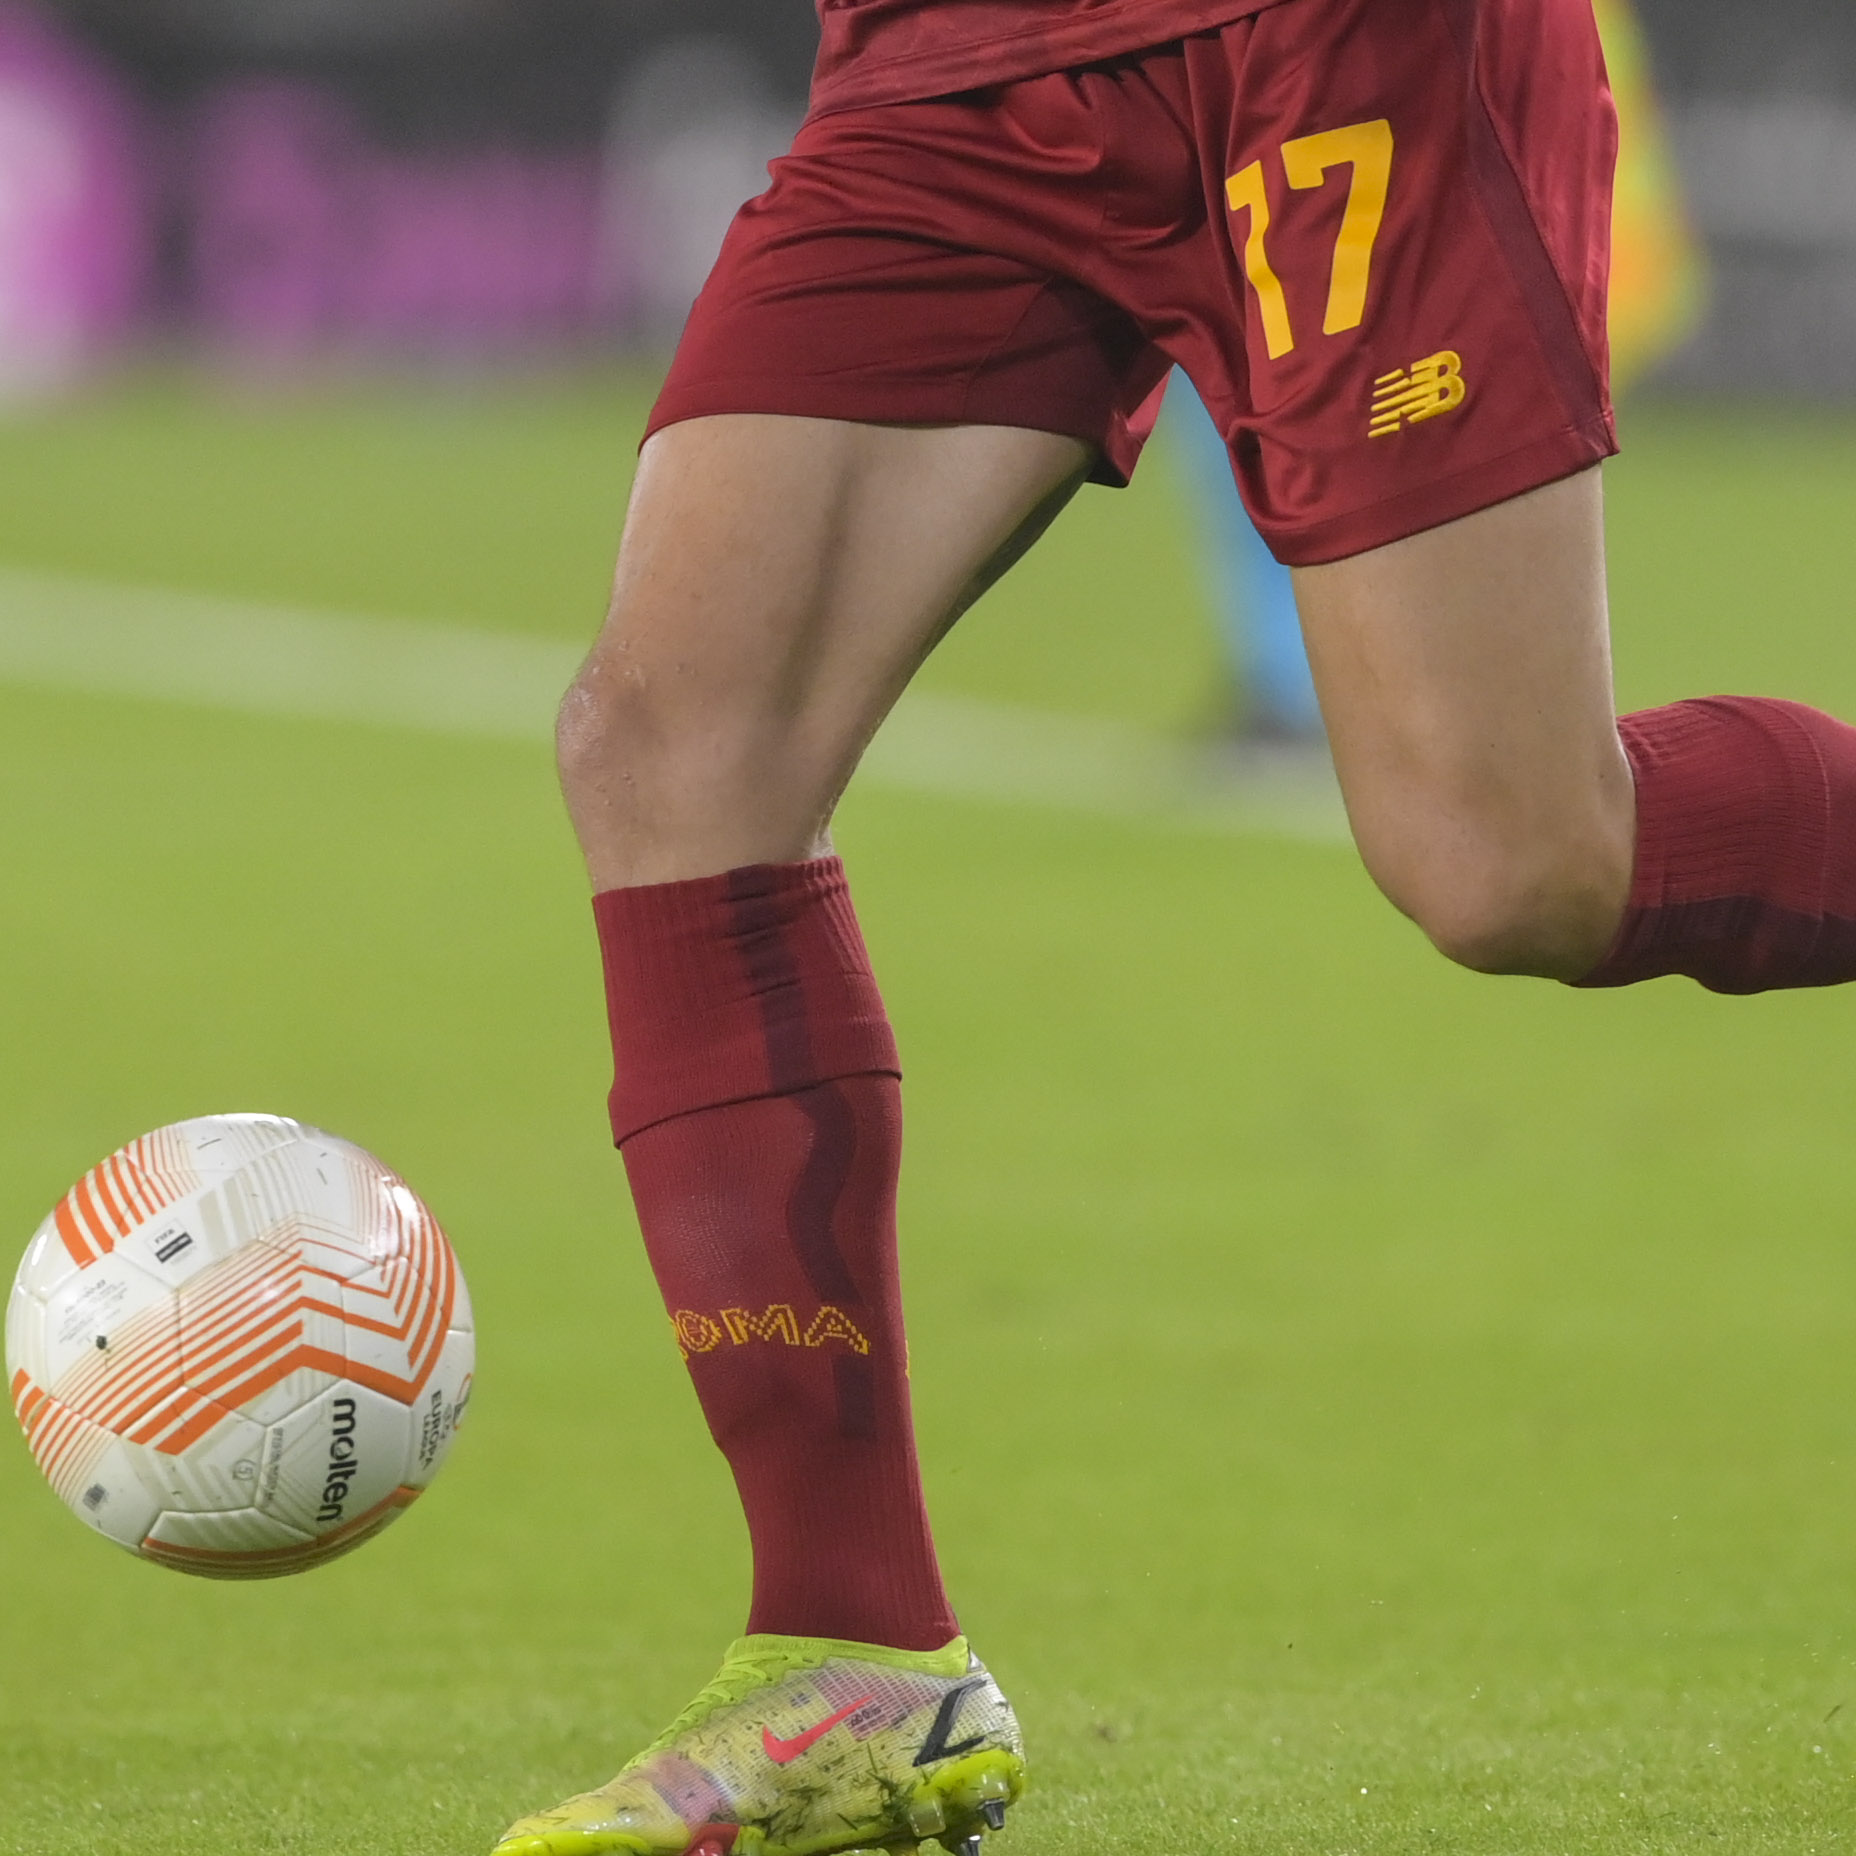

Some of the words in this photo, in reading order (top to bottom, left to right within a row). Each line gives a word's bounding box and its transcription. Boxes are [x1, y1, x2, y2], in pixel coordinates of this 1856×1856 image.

[1225, 118, 1394, 360] 17
[316, 1398, 358, 1522] molten
[423, 1389, 442, 1471] EUROPA
